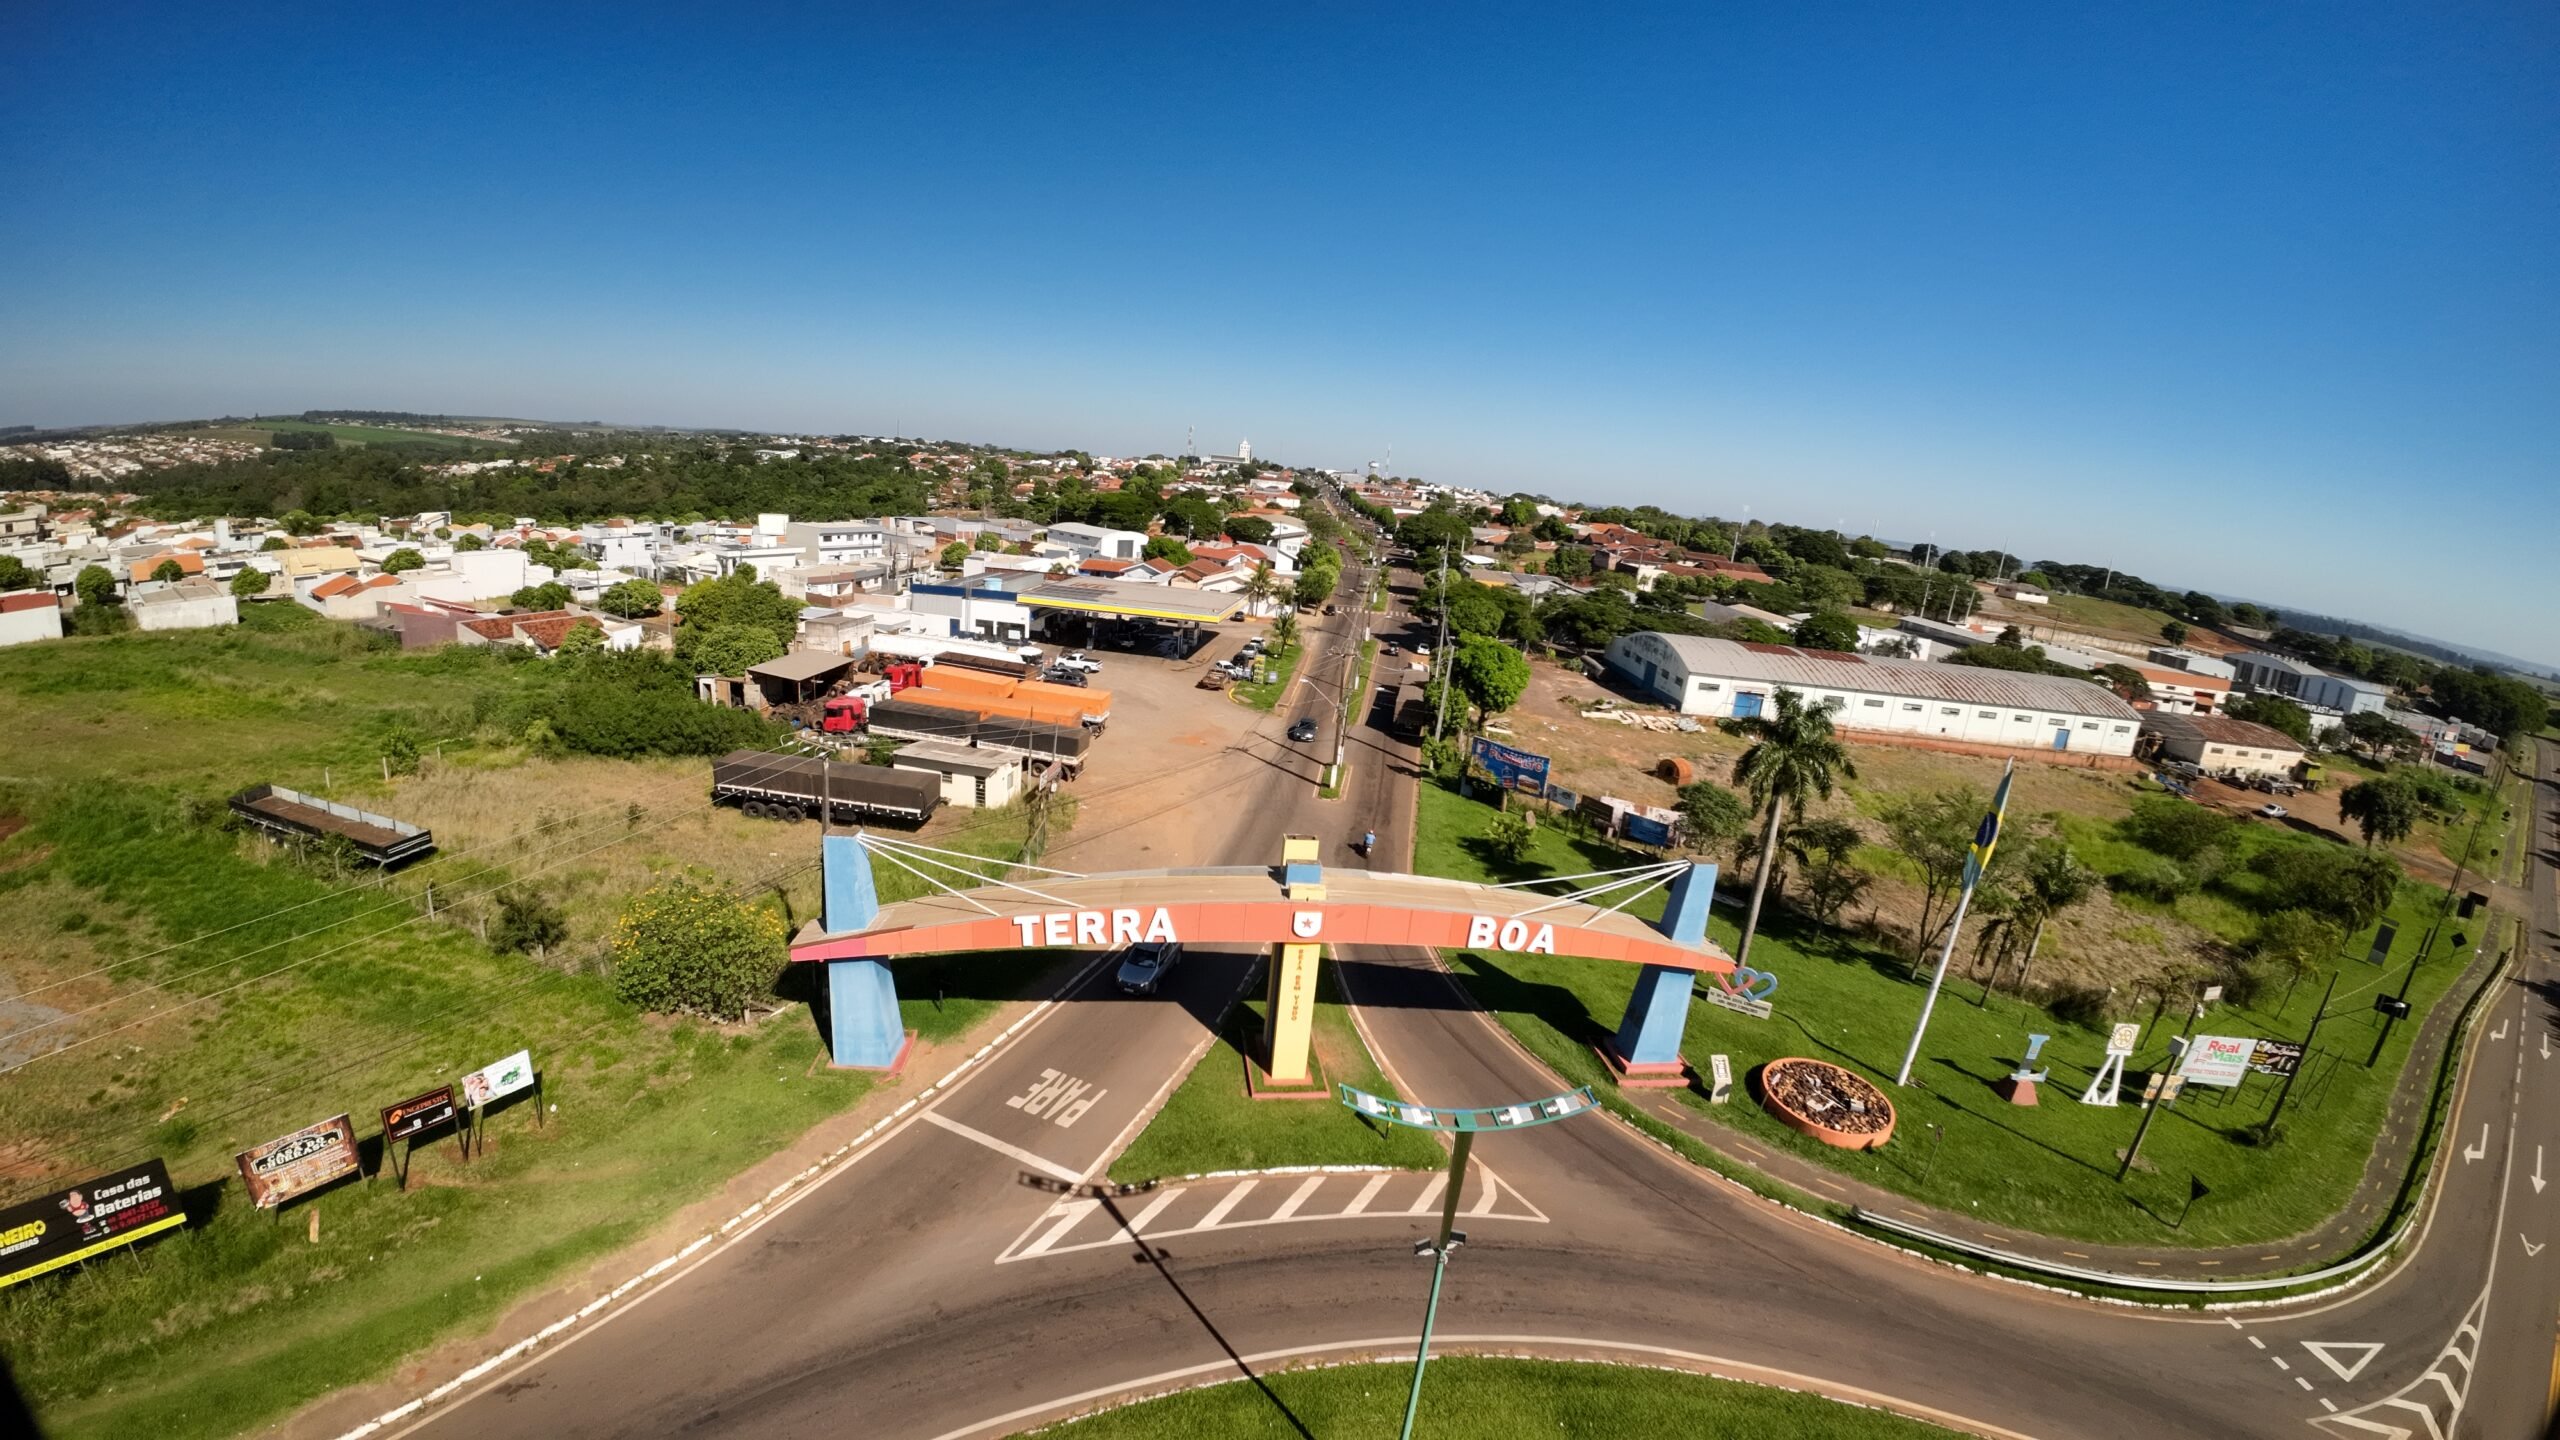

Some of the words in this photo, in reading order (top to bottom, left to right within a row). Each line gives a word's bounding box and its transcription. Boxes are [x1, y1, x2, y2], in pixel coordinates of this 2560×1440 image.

[1012, 907, 1177, 947] TERRA
[1467, 915, 1555, 954] BOA
[2208, 1040, 2241, 1053] Real
[2212, 1051, 2245, 1063] Mais
[1005, 1067, 1108, 1128] PARE
[259, 1137, 337, 1171] CHURRASCO
[94, 1184, 125, 1201] Casa
[126, 1175, 151, 1190] das
[94, 1186, 162, 1218] Baterias
[0, 1237, 40, 1256] BATERIAS
